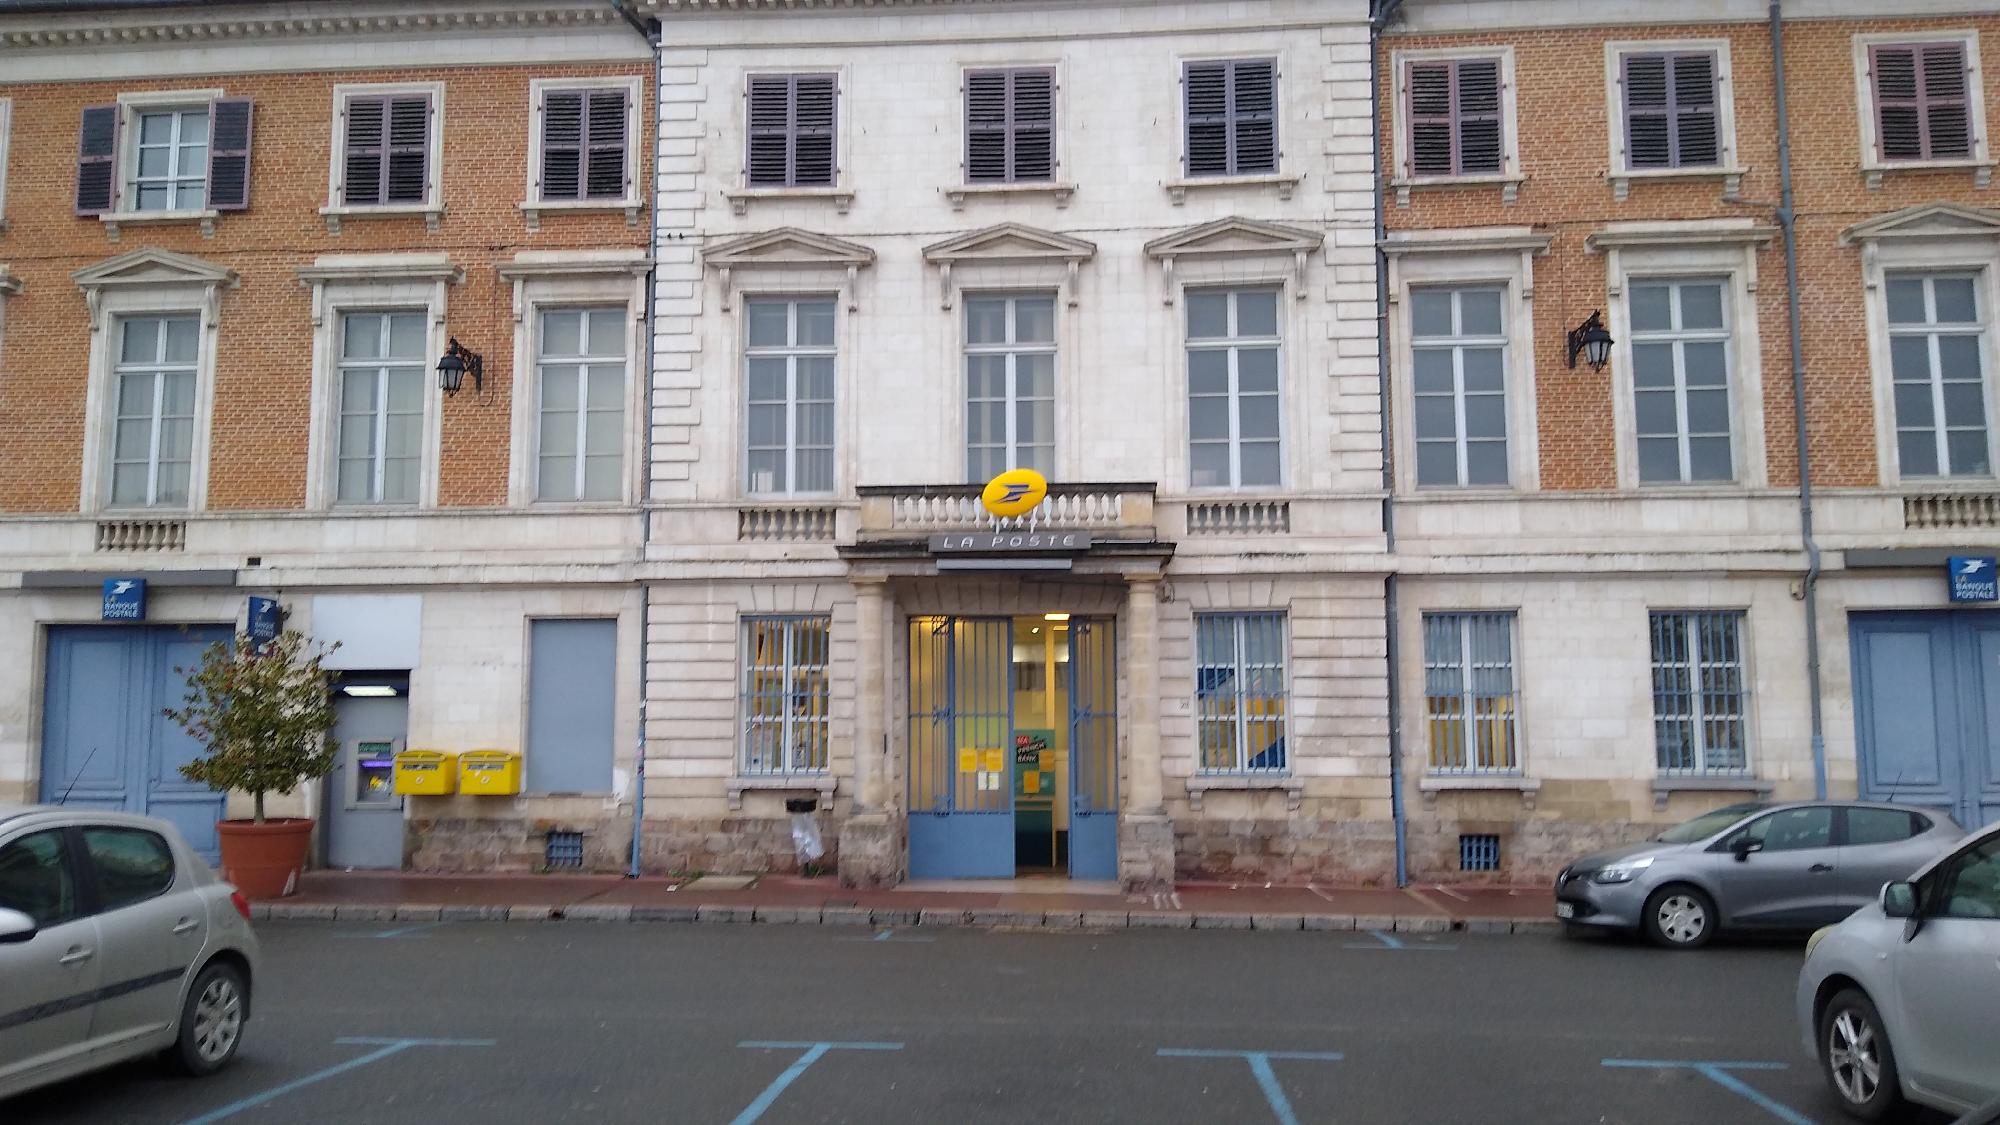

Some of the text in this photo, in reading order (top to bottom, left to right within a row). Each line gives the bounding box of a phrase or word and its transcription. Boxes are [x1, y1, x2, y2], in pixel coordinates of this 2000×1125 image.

[943, 534, 1076, 549] LA POSTE
[1955, 582, 1994, 591] BANQUE
[1956, 591, 1994, 599] POSTALE
[104, 602, 138, 610] BANQUE
[104, 610, 138, 618] POSTALE
